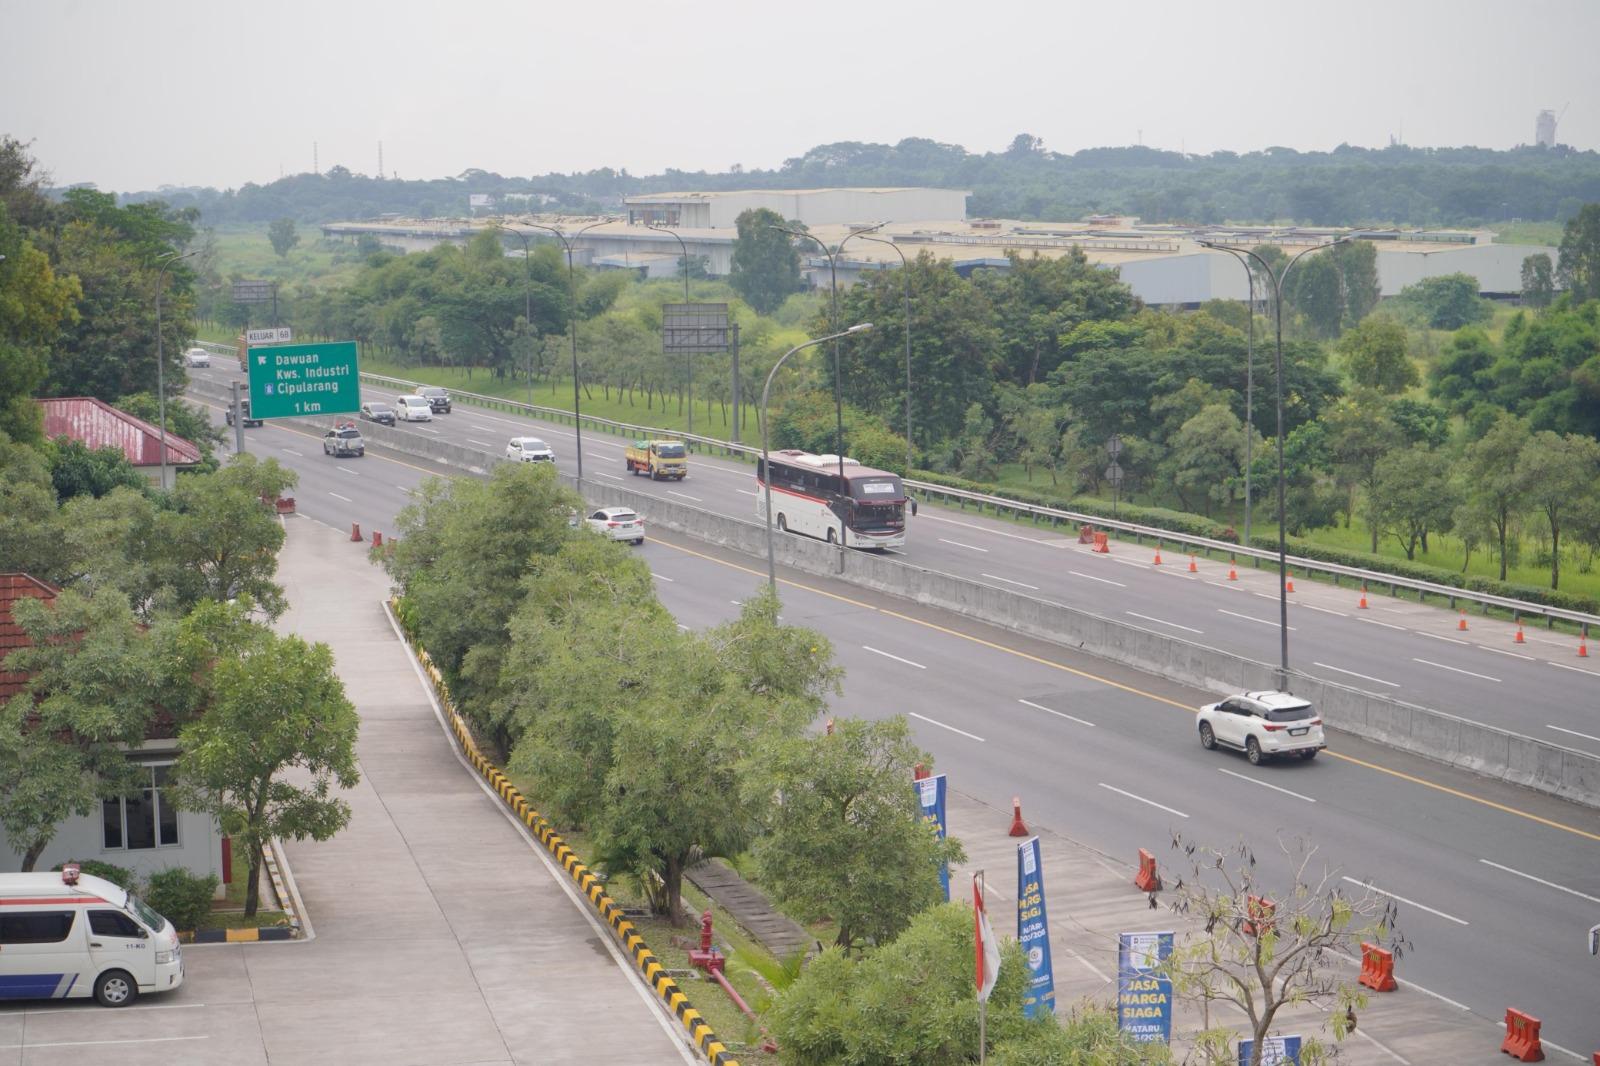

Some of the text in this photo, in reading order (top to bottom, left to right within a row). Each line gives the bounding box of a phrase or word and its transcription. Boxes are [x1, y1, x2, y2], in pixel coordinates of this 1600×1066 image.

[249, 332, 274, 341] KELUAR
[276, 354, 318, 366] Dawuan
[276, 365, 349, 380] Kws. Industri
[277, 382, 338, 395] Cipularang
[295, 401, 321, 412] 1 km
[1127, 980, 1159, 991] JASA
[1120, 993, 1166, 1005] MARGA
[1123, 1007, 1162, 1018] SIAGA
